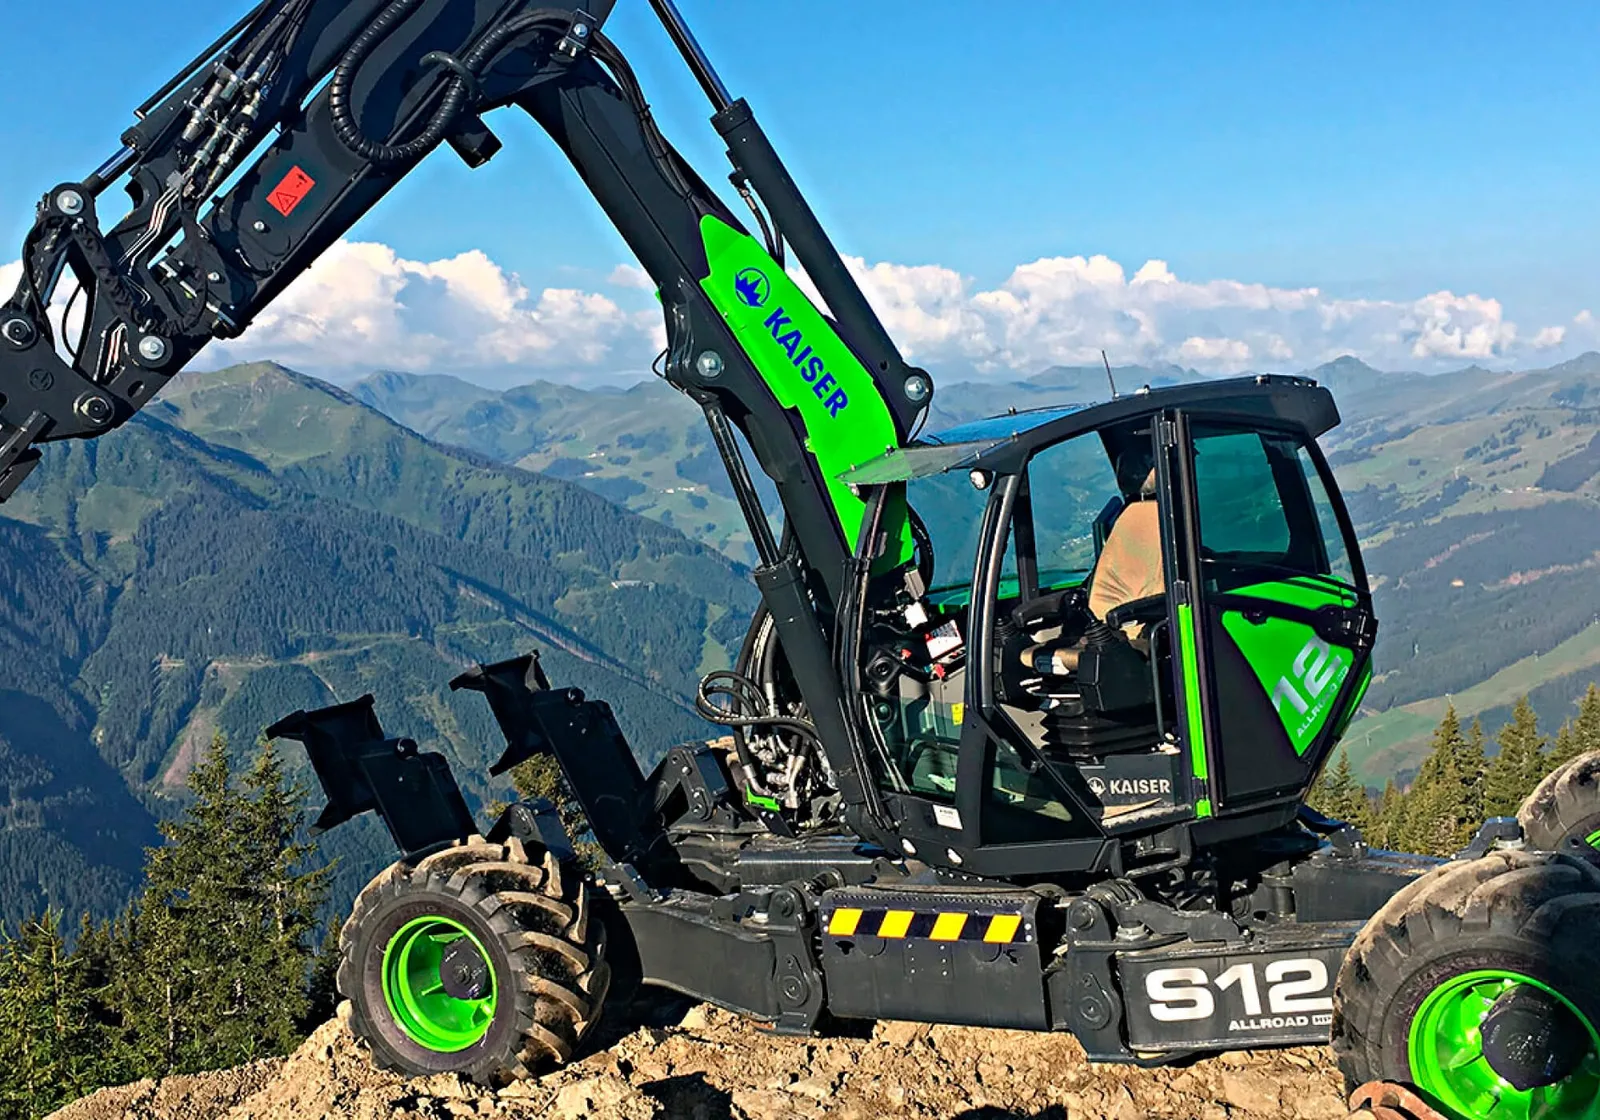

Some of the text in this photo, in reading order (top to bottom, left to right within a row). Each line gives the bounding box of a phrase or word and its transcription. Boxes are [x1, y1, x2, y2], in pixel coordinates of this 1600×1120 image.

[764, 307, 848, 418] KAISER
[1272, 634, 1342, 715] 12
[1109, 779, 1171, 795] KAISER
[1145, 958, 1333, 1022] S12
[1228, 1015, 1309, 1031] ALLROAD
